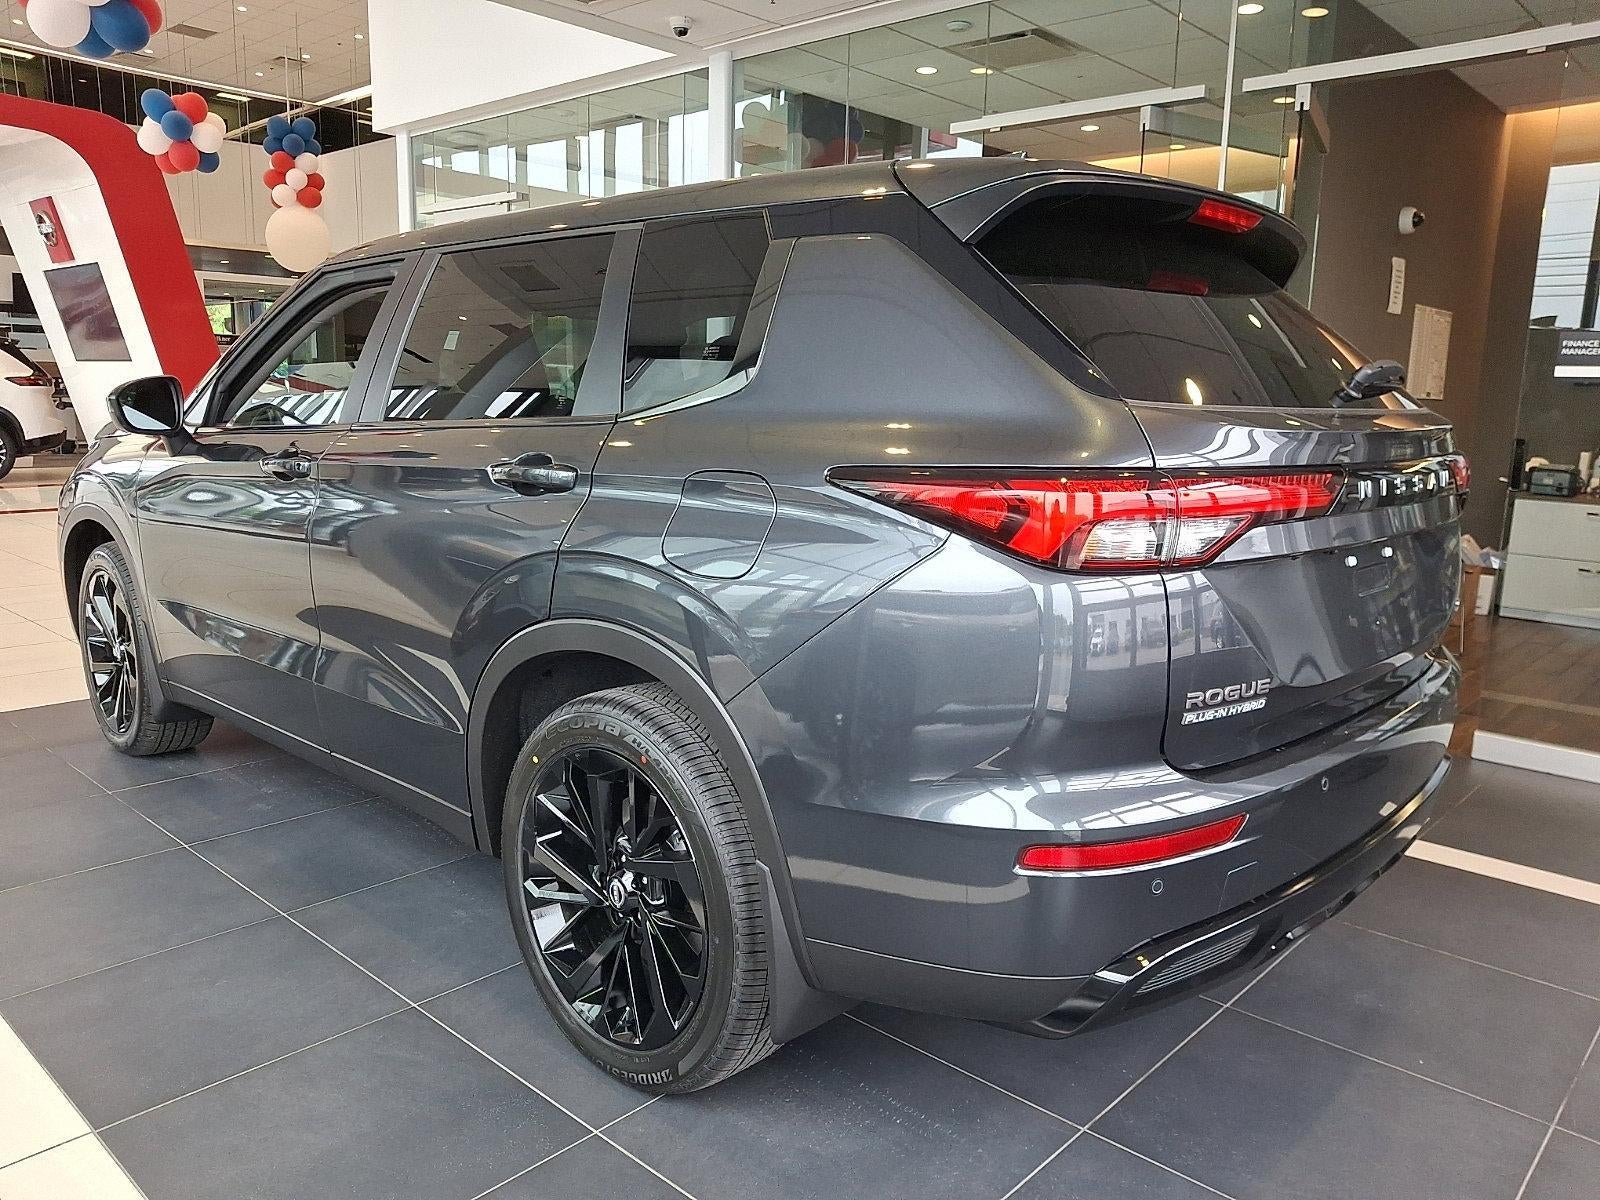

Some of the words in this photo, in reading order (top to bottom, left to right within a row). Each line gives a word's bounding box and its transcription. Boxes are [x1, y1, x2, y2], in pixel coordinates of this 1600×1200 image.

[1185, 678, 1271, 709] ROGUE
[1184, 708, 1227, 725] PLUG-IN
[1228, 699, 1267, 715] HYBRID
